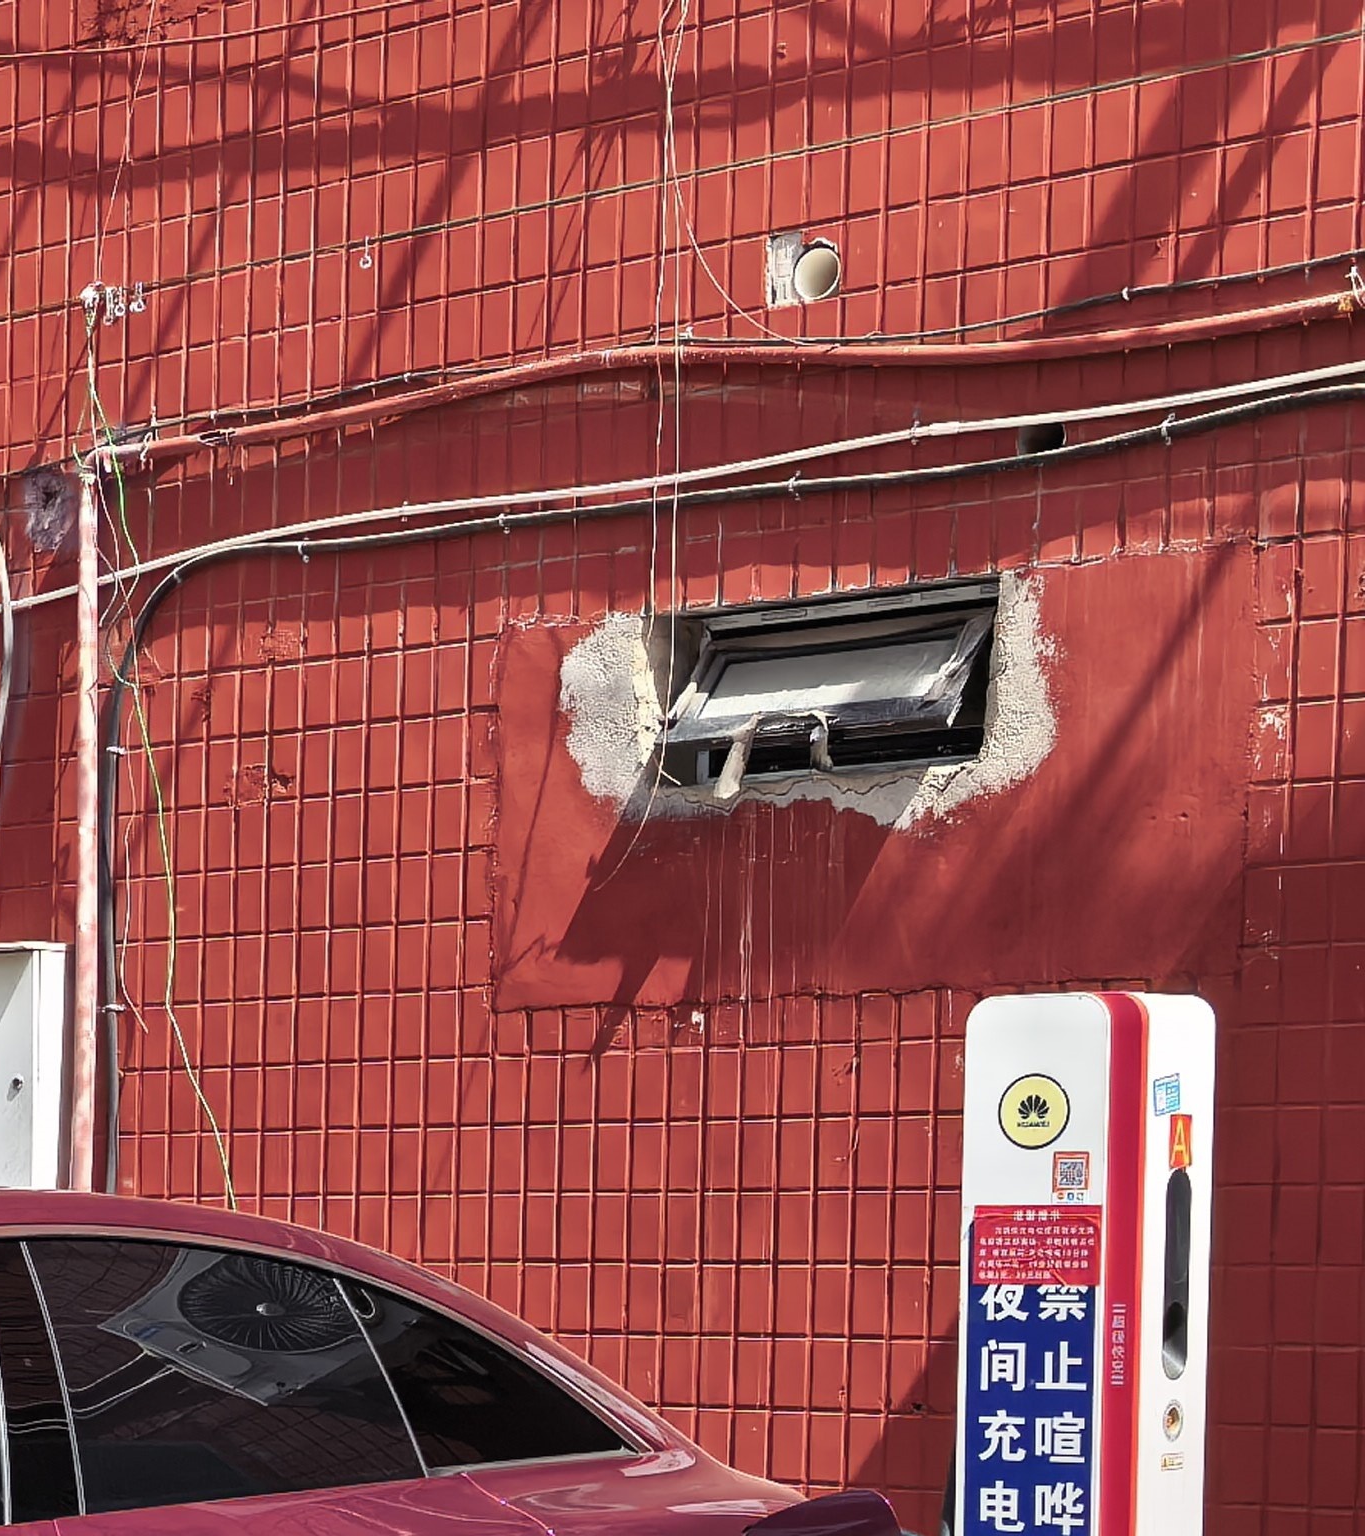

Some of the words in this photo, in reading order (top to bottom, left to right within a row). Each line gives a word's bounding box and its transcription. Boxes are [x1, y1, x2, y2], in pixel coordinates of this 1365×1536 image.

[1169, 1118, 1190, 1167] A
[978, 1284, 1029, 1533] 夜间充电
[1034, 1284, 1088, 1536] 禁止喧哗
